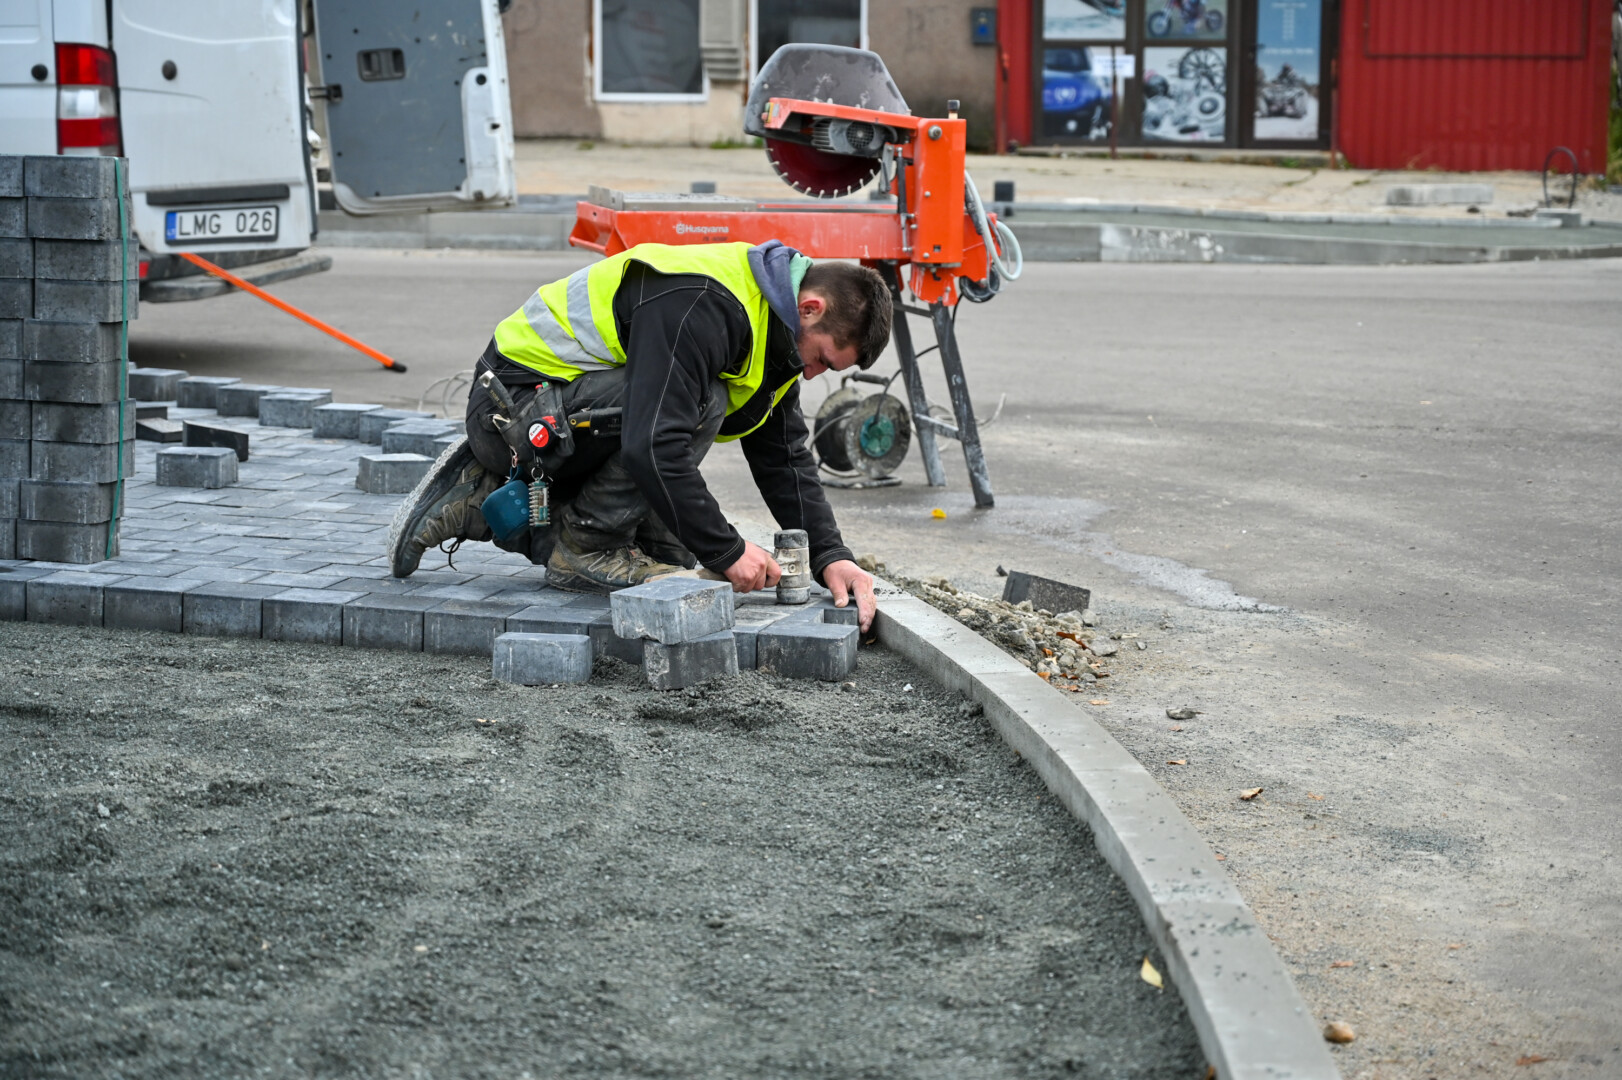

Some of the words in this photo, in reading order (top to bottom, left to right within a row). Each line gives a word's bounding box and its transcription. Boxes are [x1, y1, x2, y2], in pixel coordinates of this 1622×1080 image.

[179, 214, 221, 235] LMG
[236, 211, 272, 233] 026
[685, 224, 729, 234] Husqvarna
